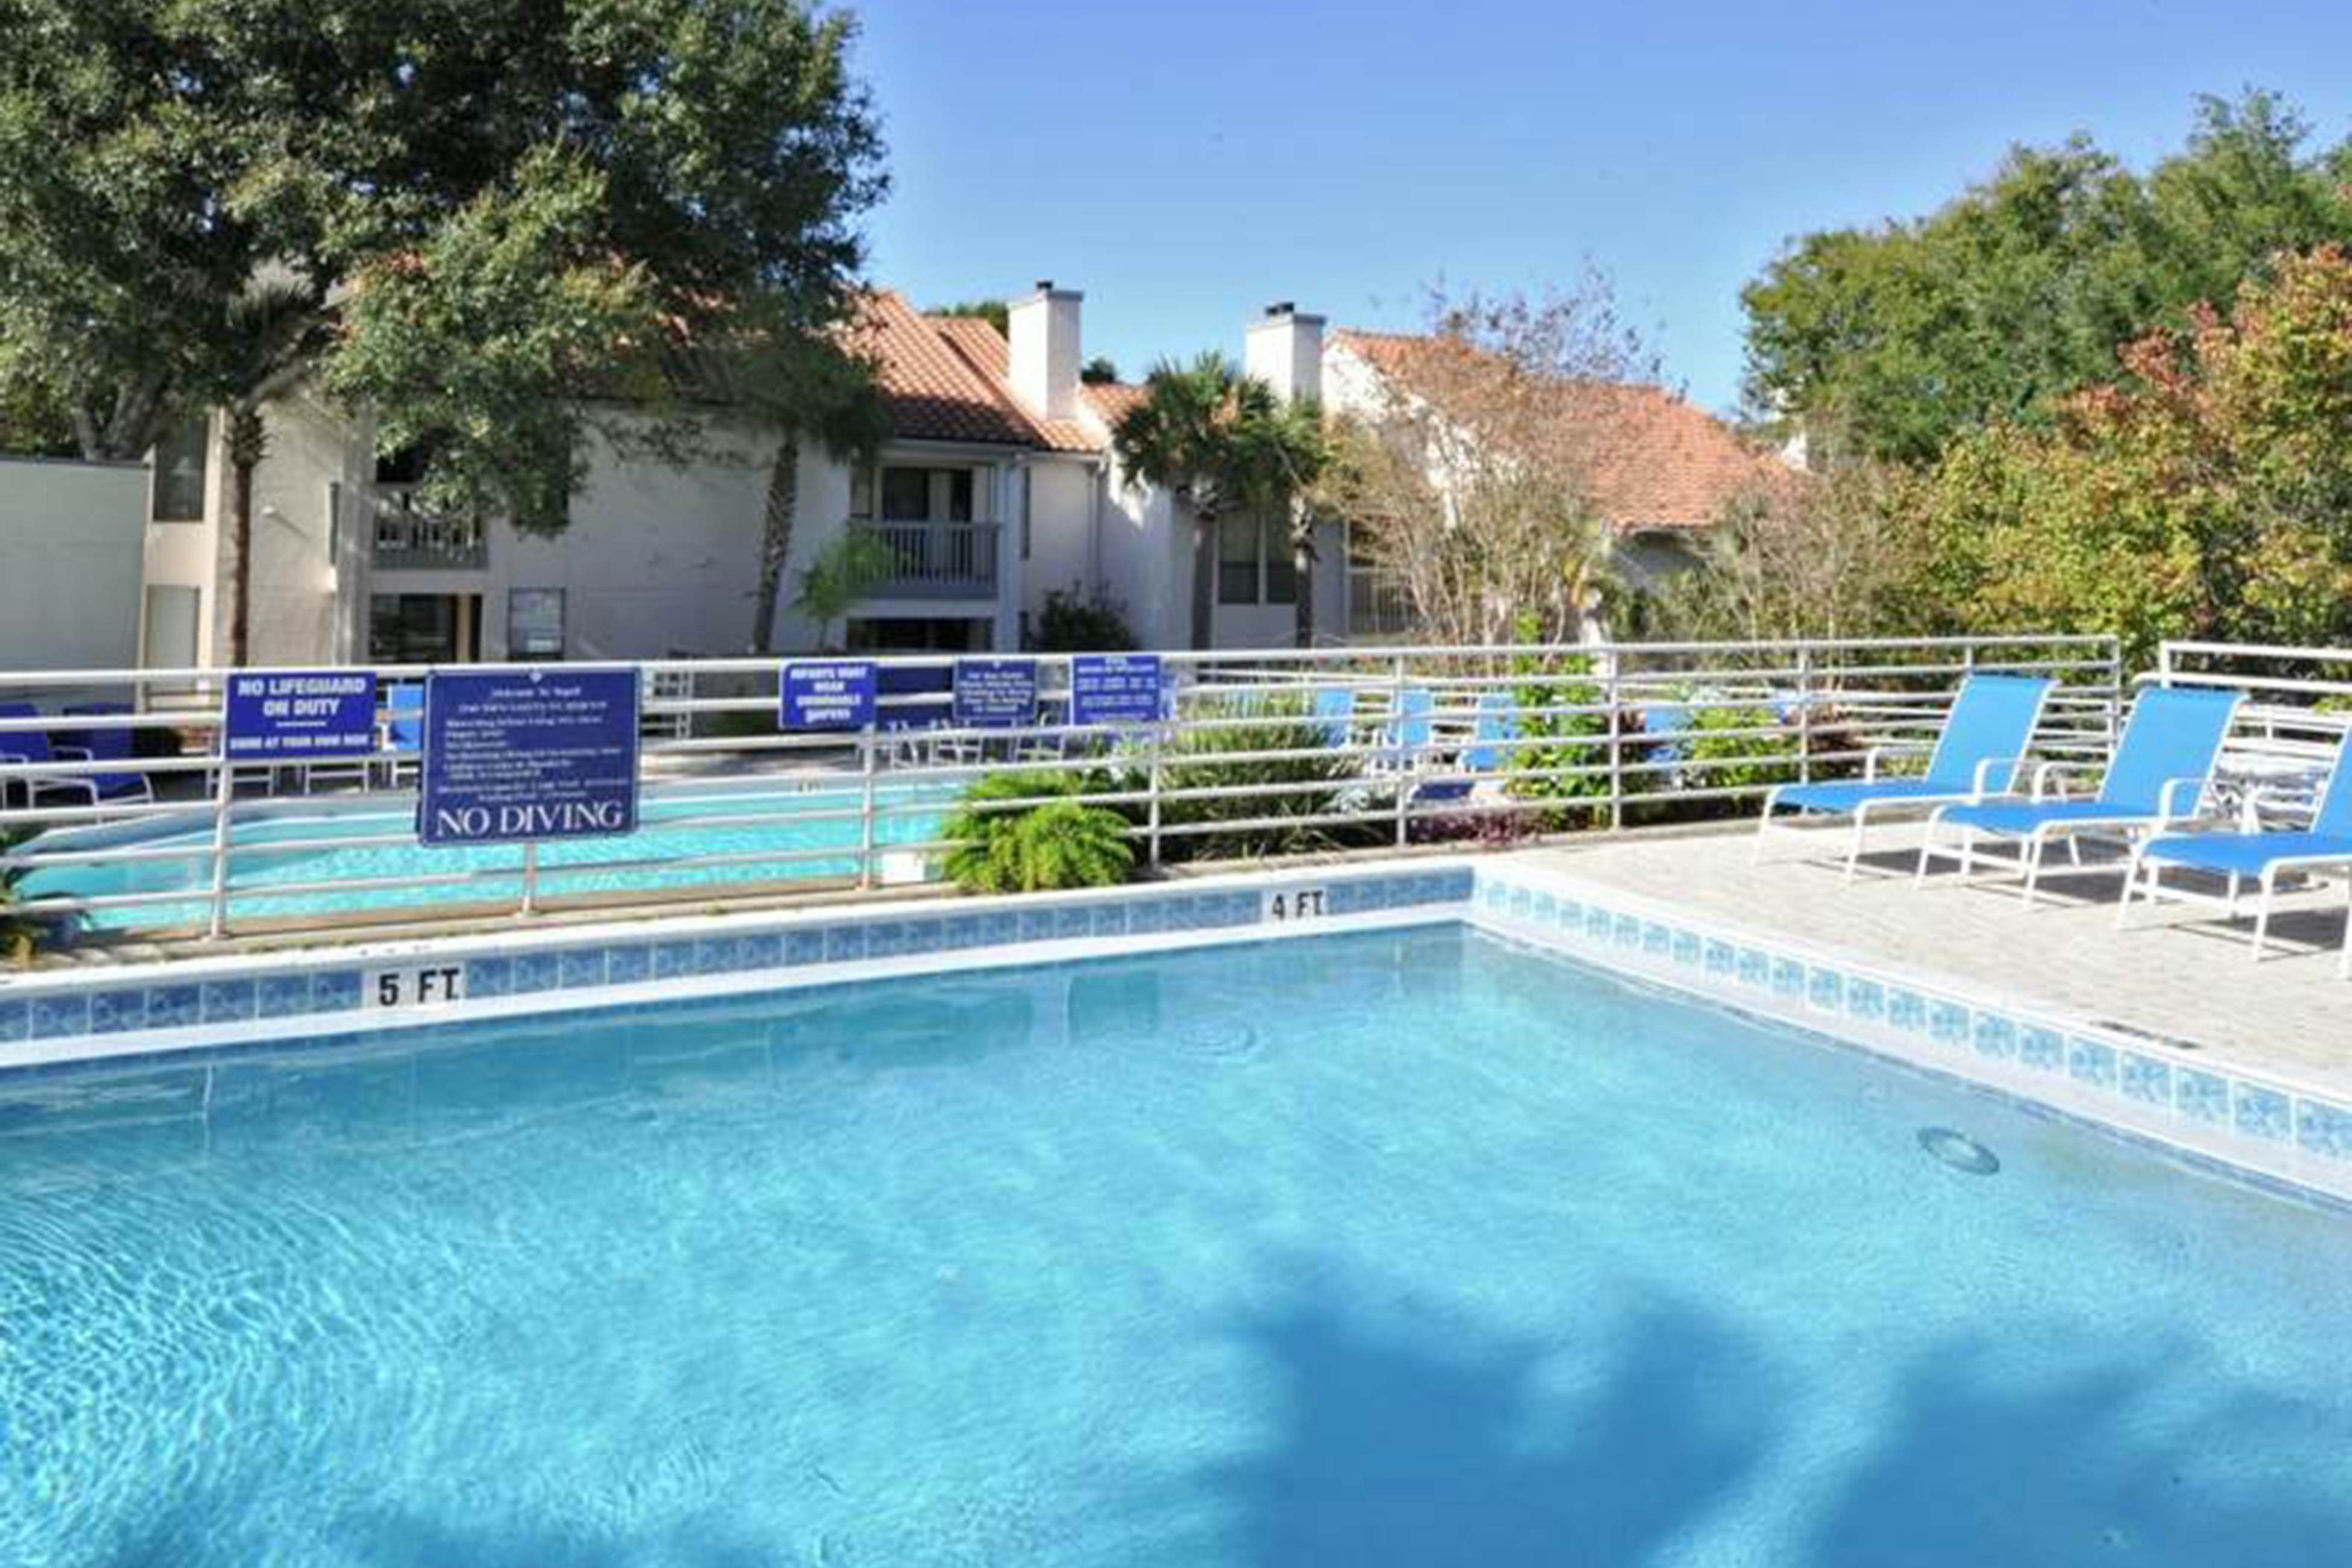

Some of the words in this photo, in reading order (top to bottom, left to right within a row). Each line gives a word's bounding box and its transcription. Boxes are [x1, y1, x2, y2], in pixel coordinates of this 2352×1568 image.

[238, 679, 264, 696] NO
[269, 678, 367, 694] LIFEGUARD
[263, 700, 289, 717] ON
[294, 698, 341, 716] DUTY
[436, 807, 491, 837] NO
[500, 801, 623, 834] DIVING
[1272, 894, 1285, 920] 4
[379, 972, 400, 1006] 5
